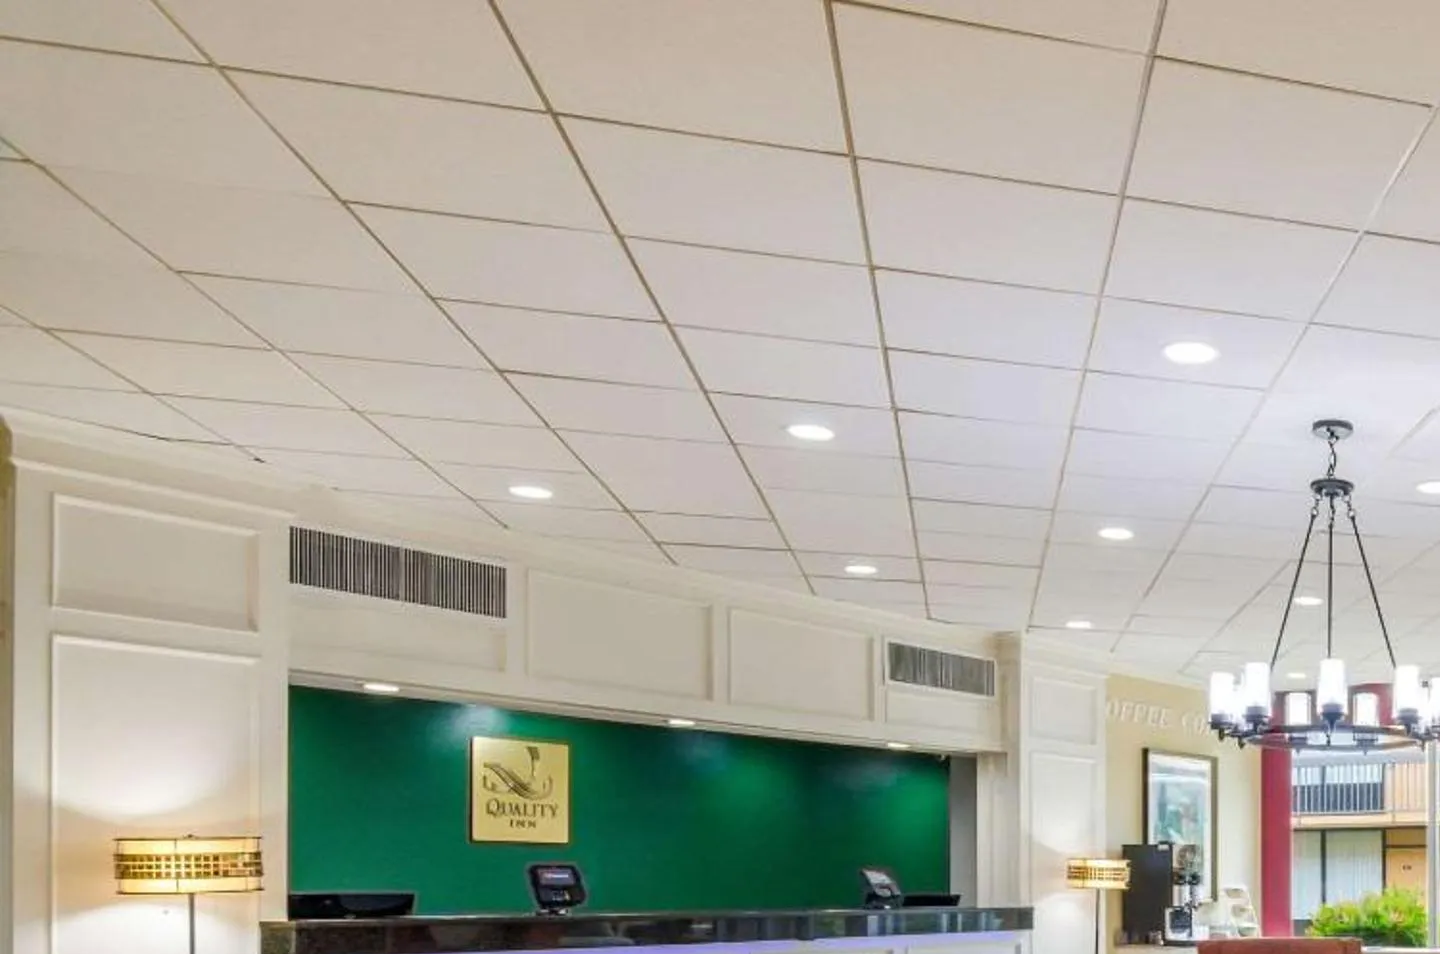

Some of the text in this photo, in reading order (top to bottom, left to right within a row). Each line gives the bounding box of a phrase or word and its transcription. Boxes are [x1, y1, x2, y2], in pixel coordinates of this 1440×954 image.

[1106, 699, 1174, 728] OFFEE
[486, 798, 558, 818] QUALITY
[509, 819, 537, 829] INN
